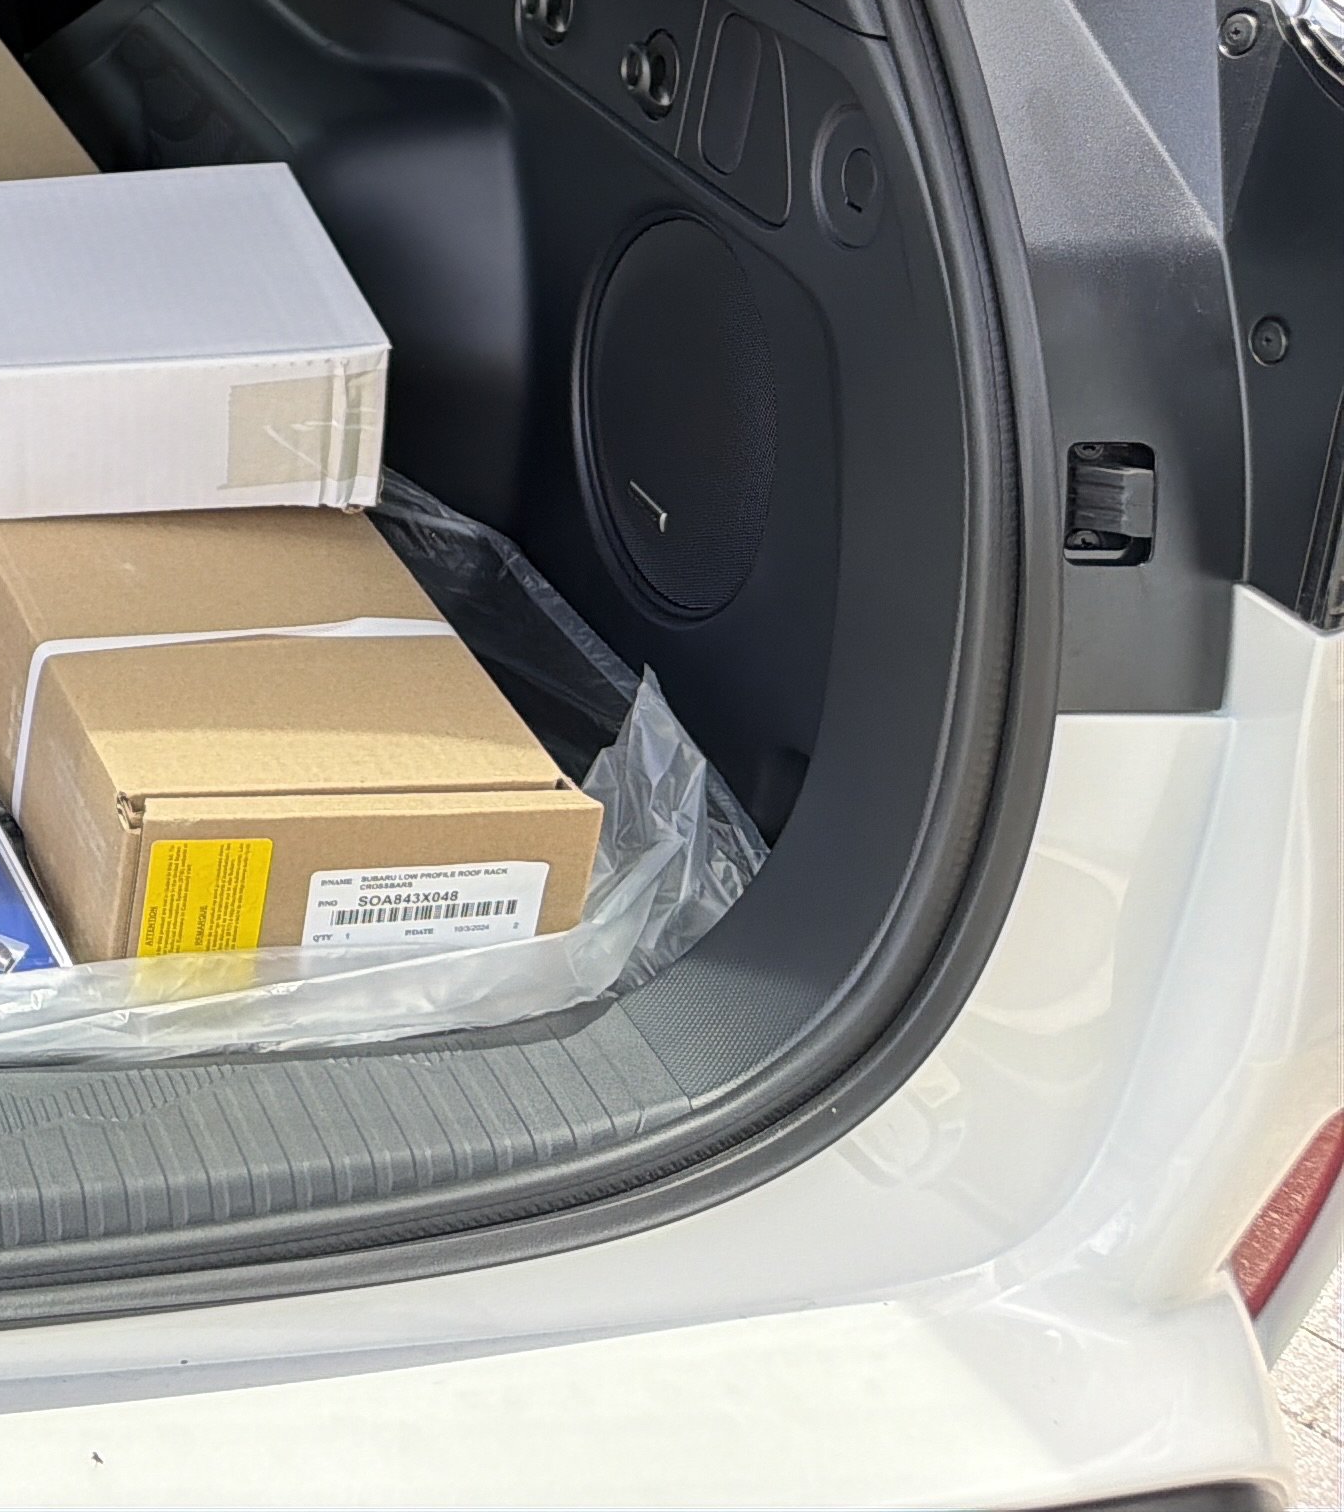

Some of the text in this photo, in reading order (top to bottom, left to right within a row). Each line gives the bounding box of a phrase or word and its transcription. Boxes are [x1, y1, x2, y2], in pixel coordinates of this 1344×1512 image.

[361, 873, 397, 883] SUBARU
[398, 872, 418, 881] LOW
[420, 870, 456, 880] PROFILE
[458, 868, 482, 878] ROOF
[483, 866, 508, 876] RACK
[359, 881, 413, 891] CROSSBARS
[358, 890, 459, 907] SOA843X048
